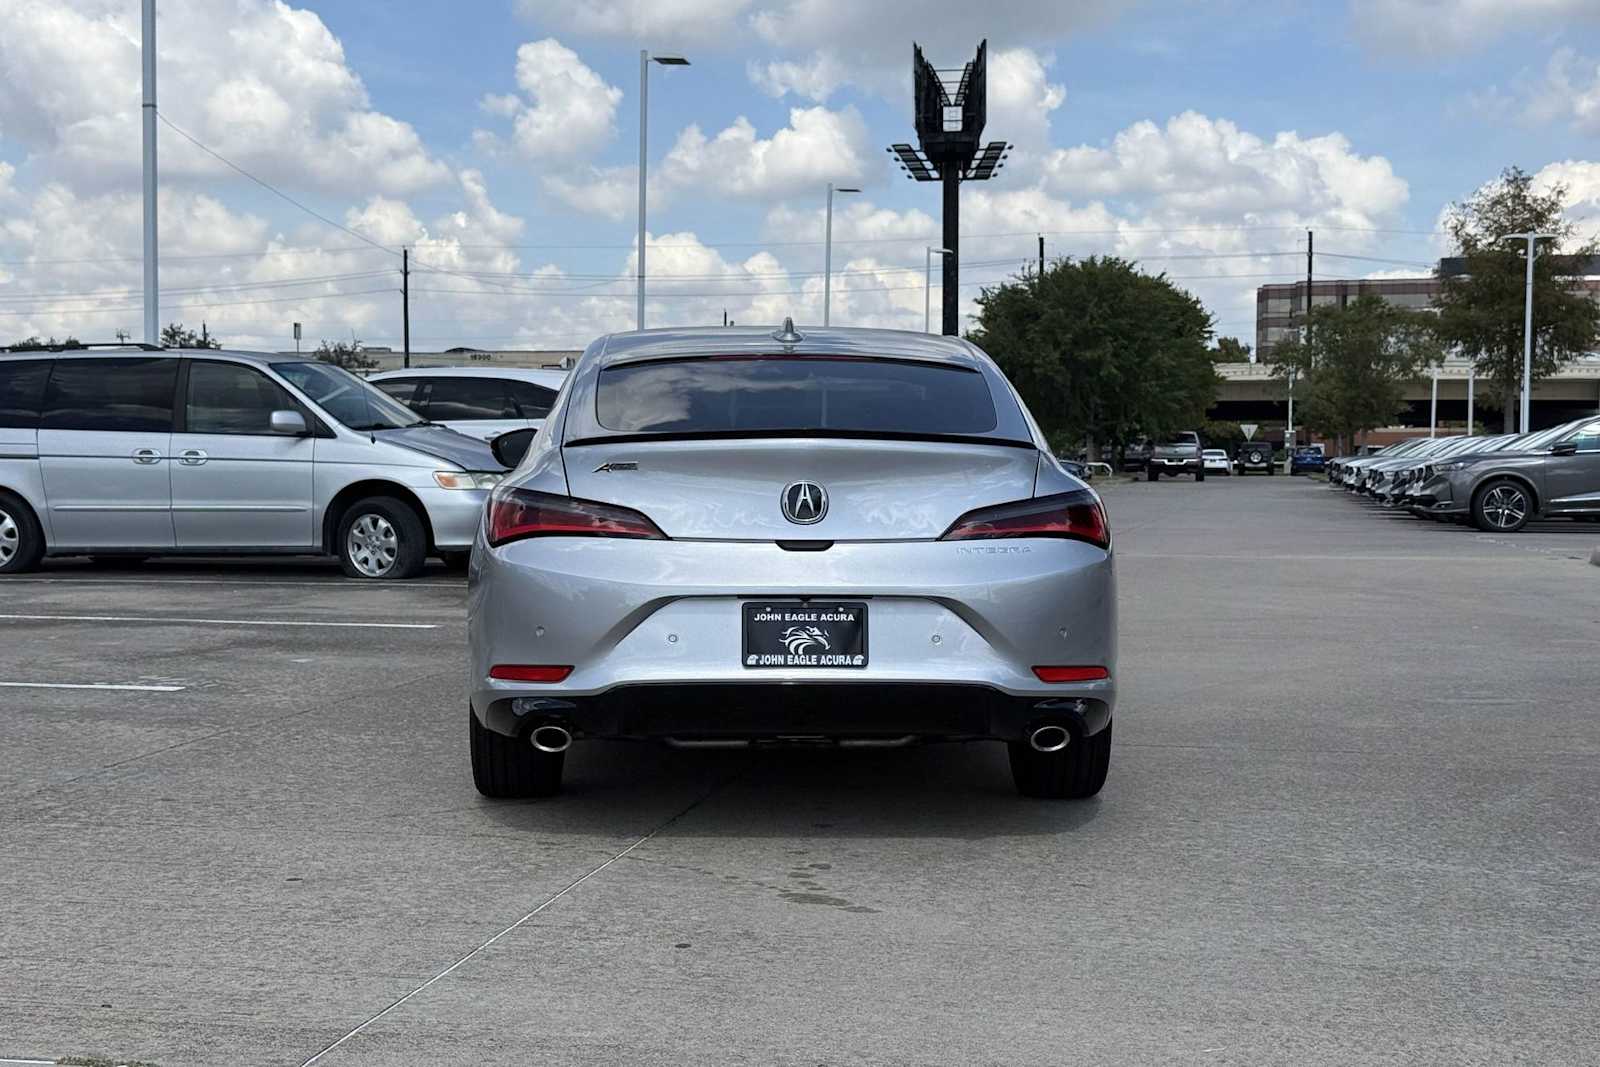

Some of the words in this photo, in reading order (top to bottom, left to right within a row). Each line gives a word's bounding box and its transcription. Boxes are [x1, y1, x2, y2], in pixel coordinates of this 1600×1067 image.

[754, 613, 782, 621] JOHN
[785, 613, 817, 621] EAGLE
[820, 613, 855, 621] ACURA
[759, 654, 784, 665] JOHN
[787, 654, 817, 665] EAGLE
[820, 654, 852, 665] ACURA
